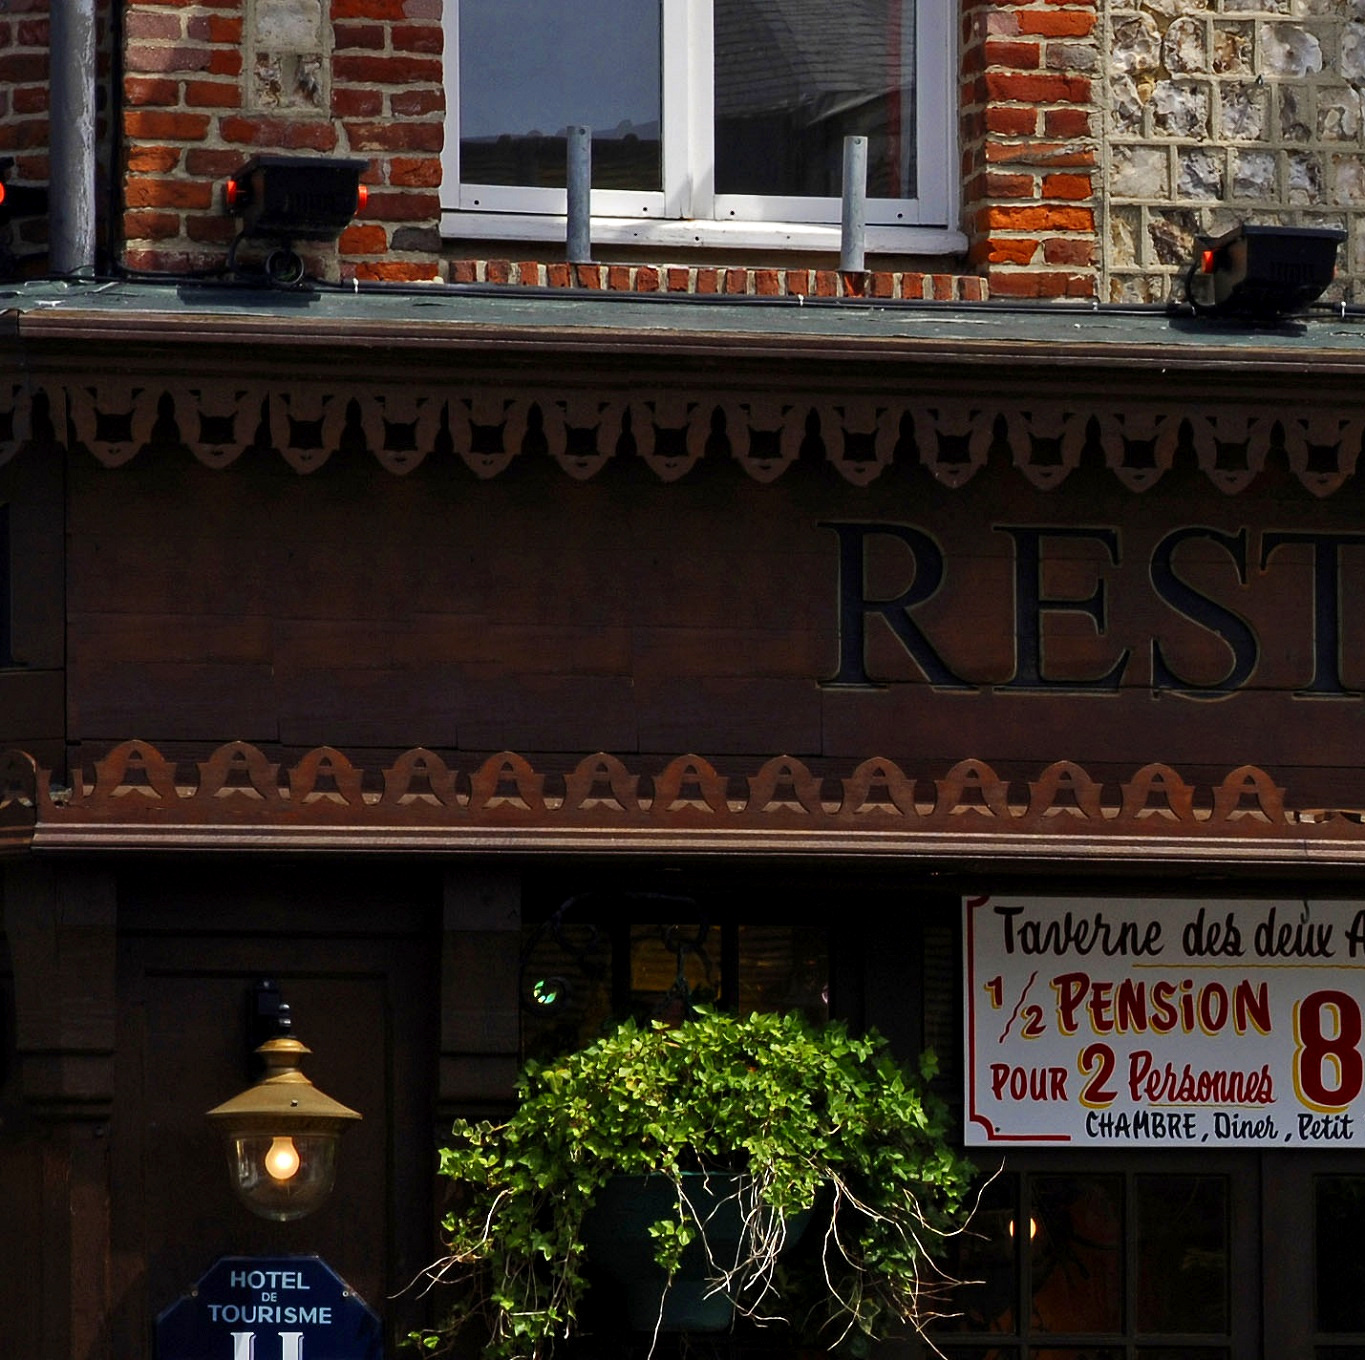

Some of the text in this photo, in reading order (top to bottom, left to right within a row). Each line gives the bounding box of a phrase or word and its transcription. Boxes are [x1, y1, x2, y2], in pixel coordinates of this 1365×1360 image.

[994, 906, 1165, 957] Taverne
[1182, 906, 1246, 958] des
[1254, 906, 1336, 958] deux
[989, 1042, 1277, 1110] POUR 2 Personnes
[1297, 1111, 1355, 1142] Petit
[230, 1270, 311, 1290] HOTEL
[261, 1292, 278, 1302] DE
[207, 1304, 332, 1324] TOURISME
